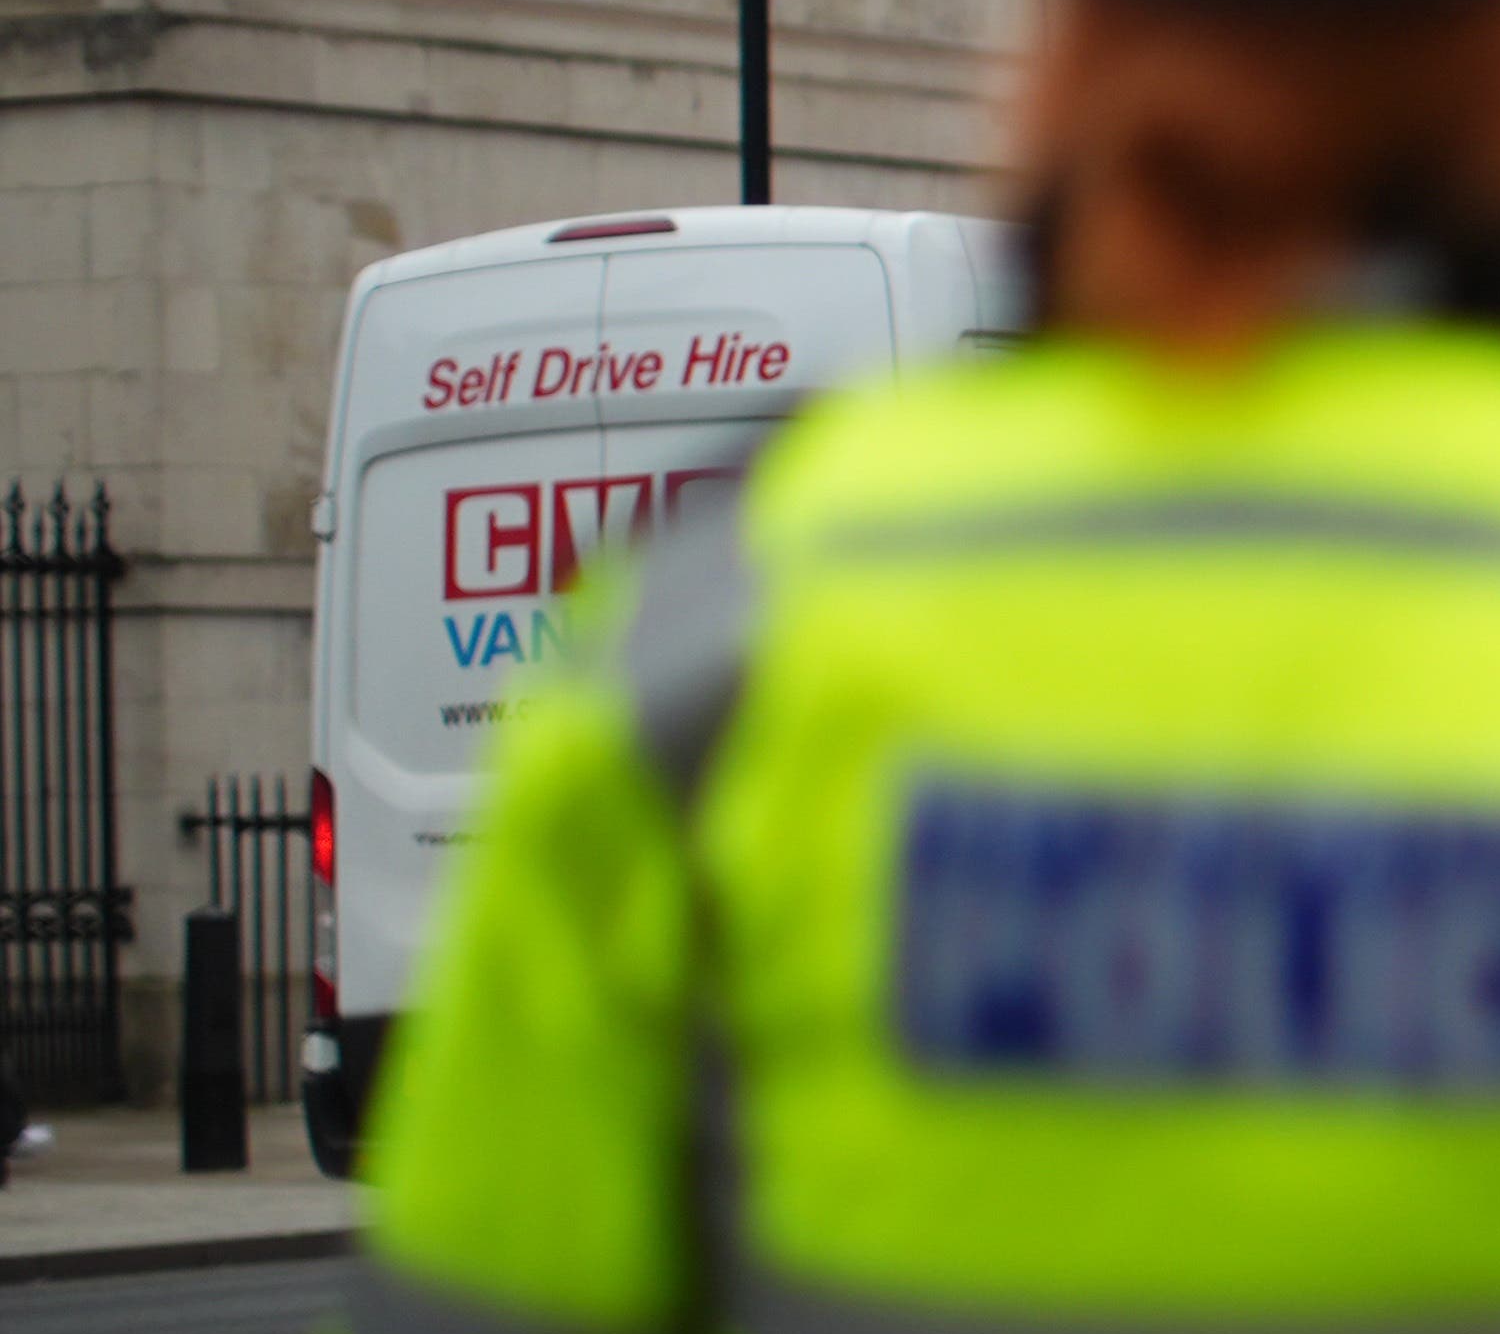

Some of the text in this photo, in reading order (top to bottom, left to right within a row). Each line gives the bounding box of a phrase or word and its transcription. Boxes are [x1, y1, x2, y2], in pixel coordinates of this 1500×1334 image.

[424, 333, 791, 411] Self Drive Hire
